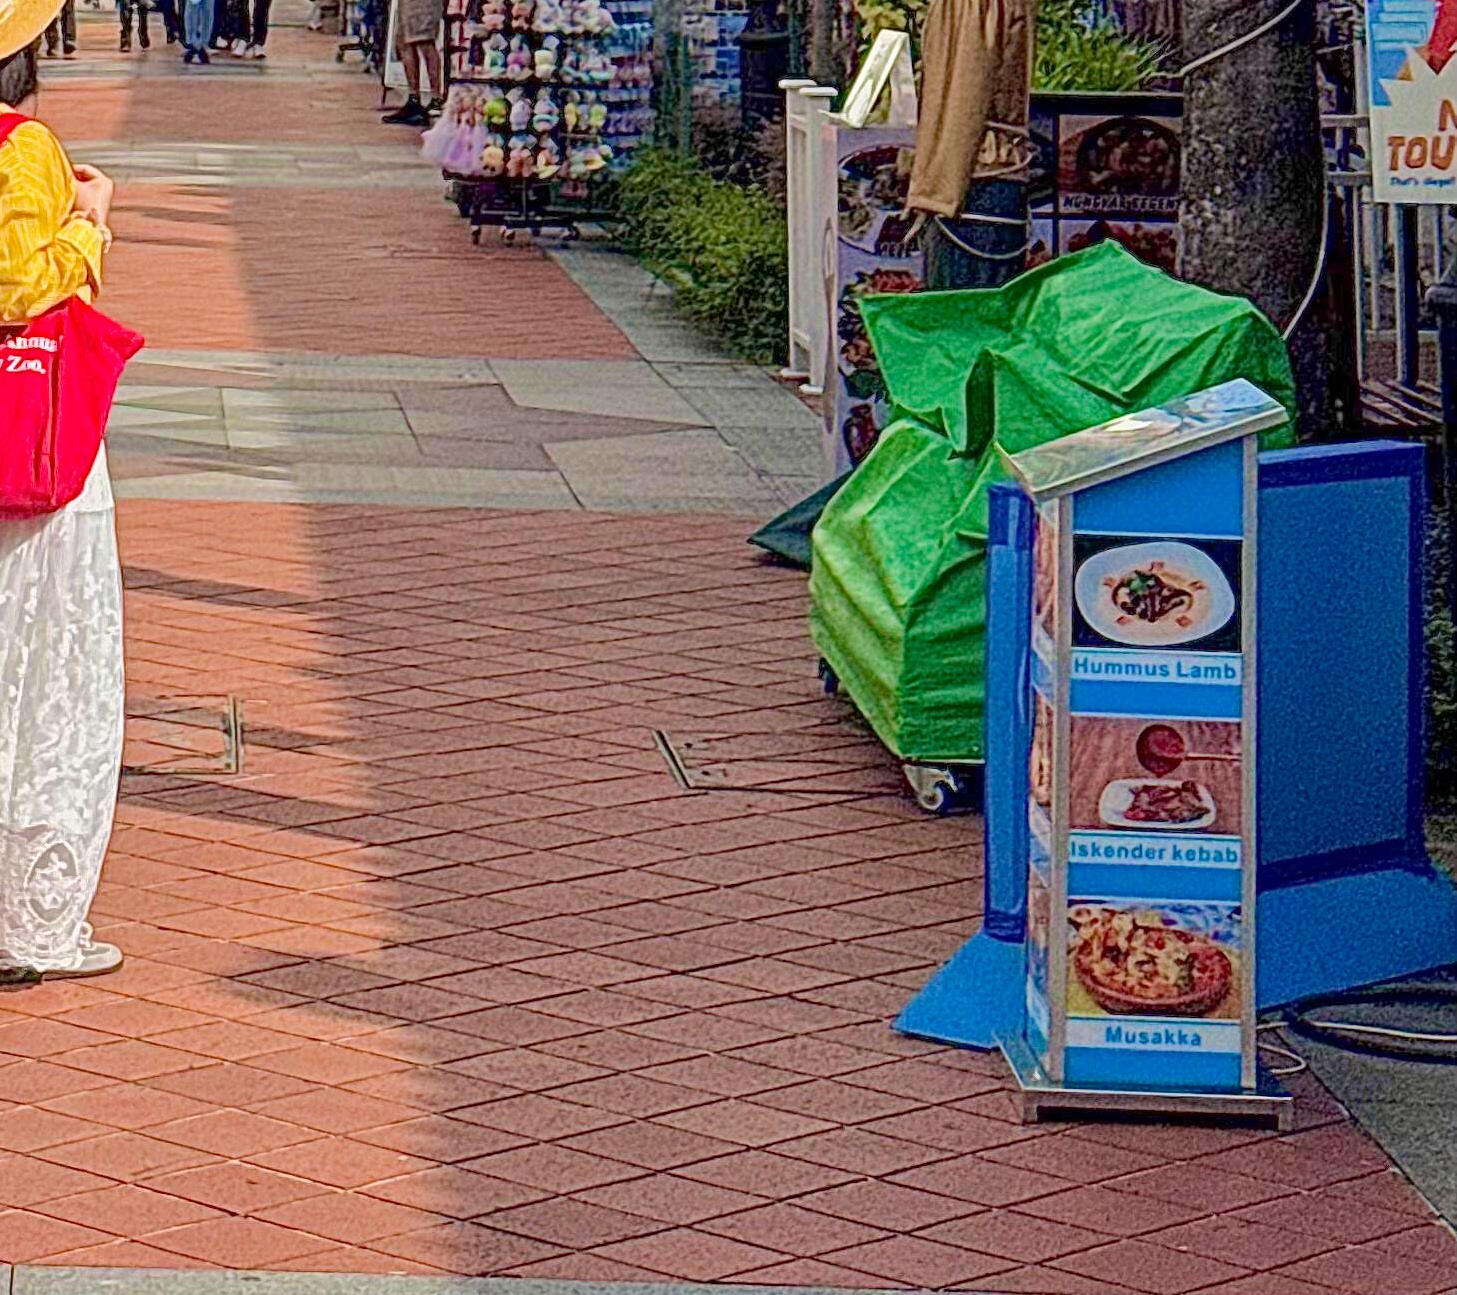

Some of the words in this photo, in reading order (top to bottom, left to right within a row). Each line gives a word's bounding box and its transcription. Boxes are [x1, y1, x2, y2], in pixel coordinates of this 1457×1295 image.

[1074, 658, 1170, 677] Hummus
[1177, 661, 1237, 680] Lamb
[1071, 841, 1167, 860] Iskender
[1172, 844, 1238, 863] kebab
[1105, 1026, 1201, 1046] Musakka
